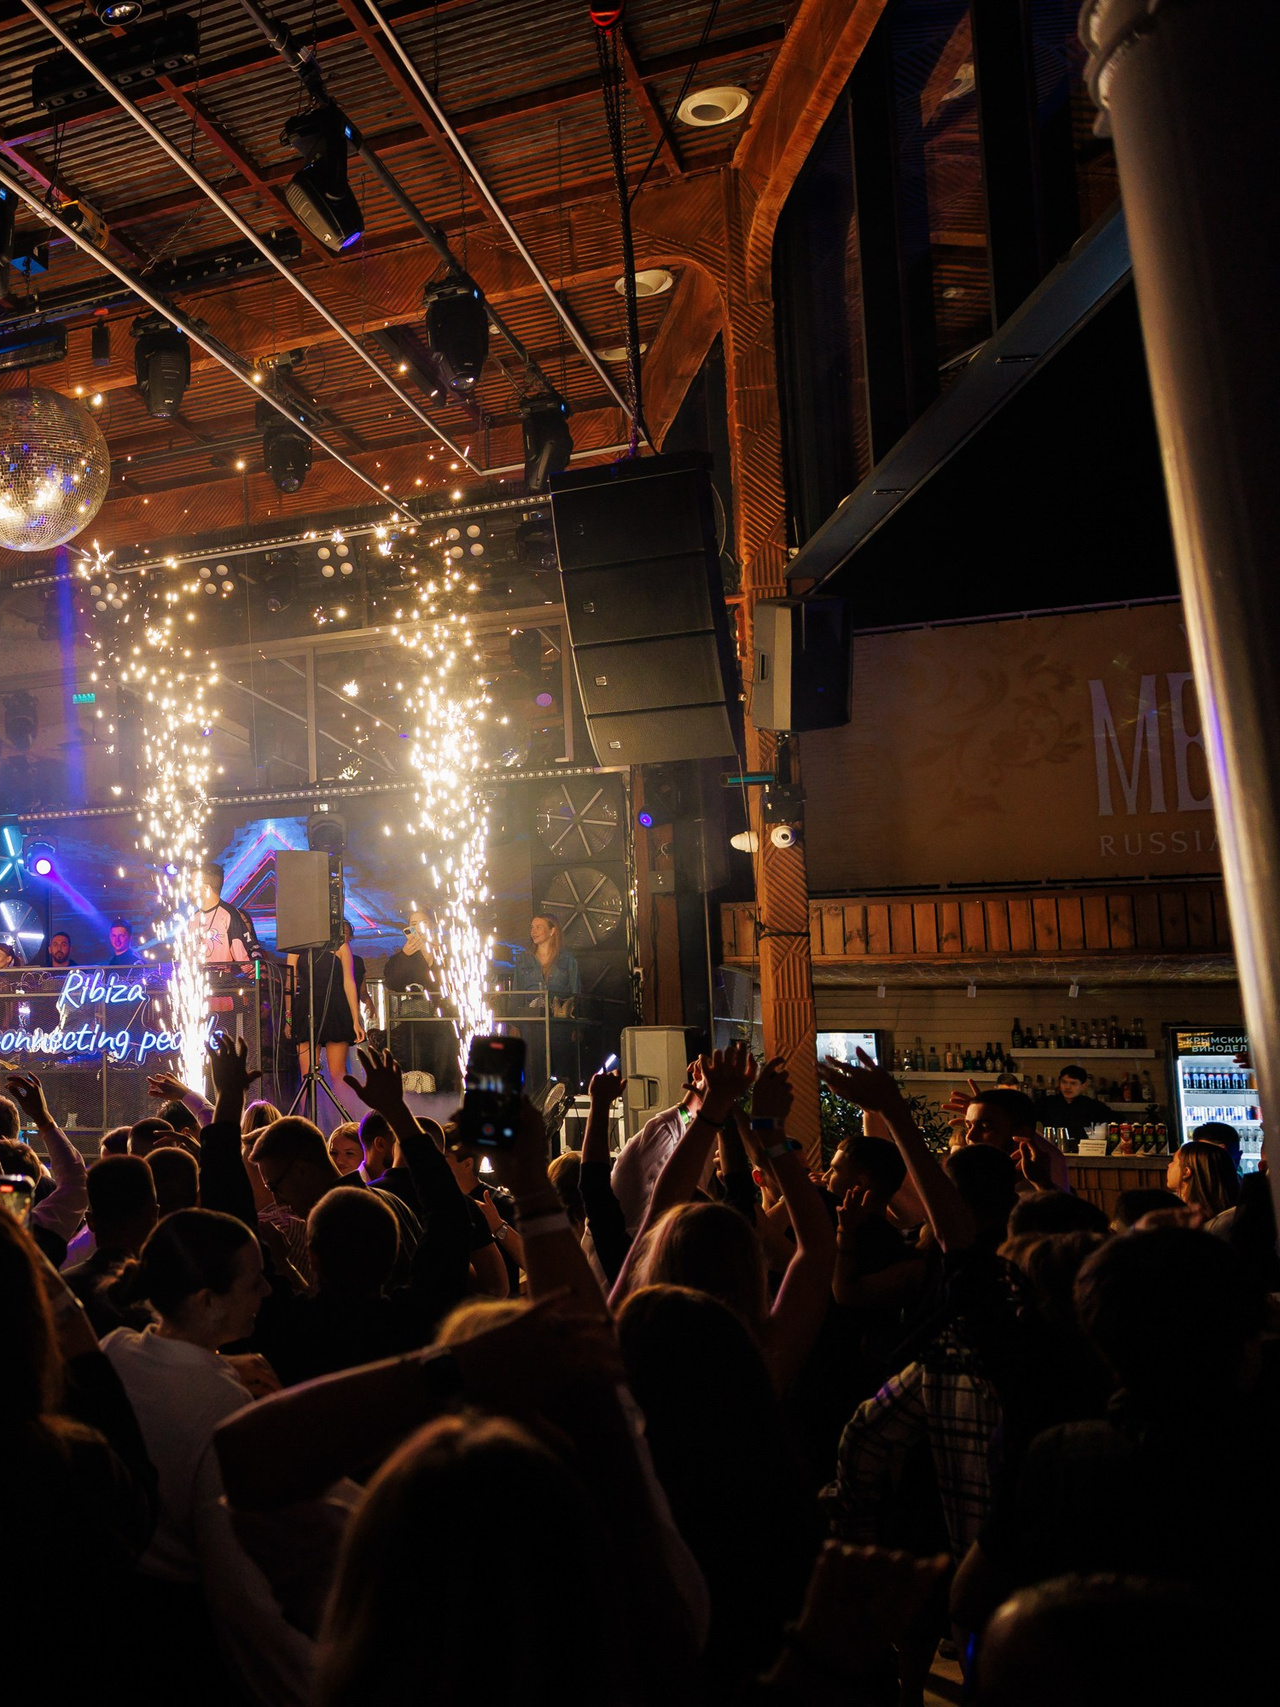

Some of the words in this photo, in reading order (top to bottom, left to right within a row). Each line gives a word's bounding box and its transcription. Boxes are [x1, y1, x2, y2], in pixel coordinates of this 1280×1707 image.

[59, 971, 147, 1009] Ribiza
[138, 1015, 224, 1062] peole
[1191, 1045, 1247, 1053] ВИНОДЕЛ
